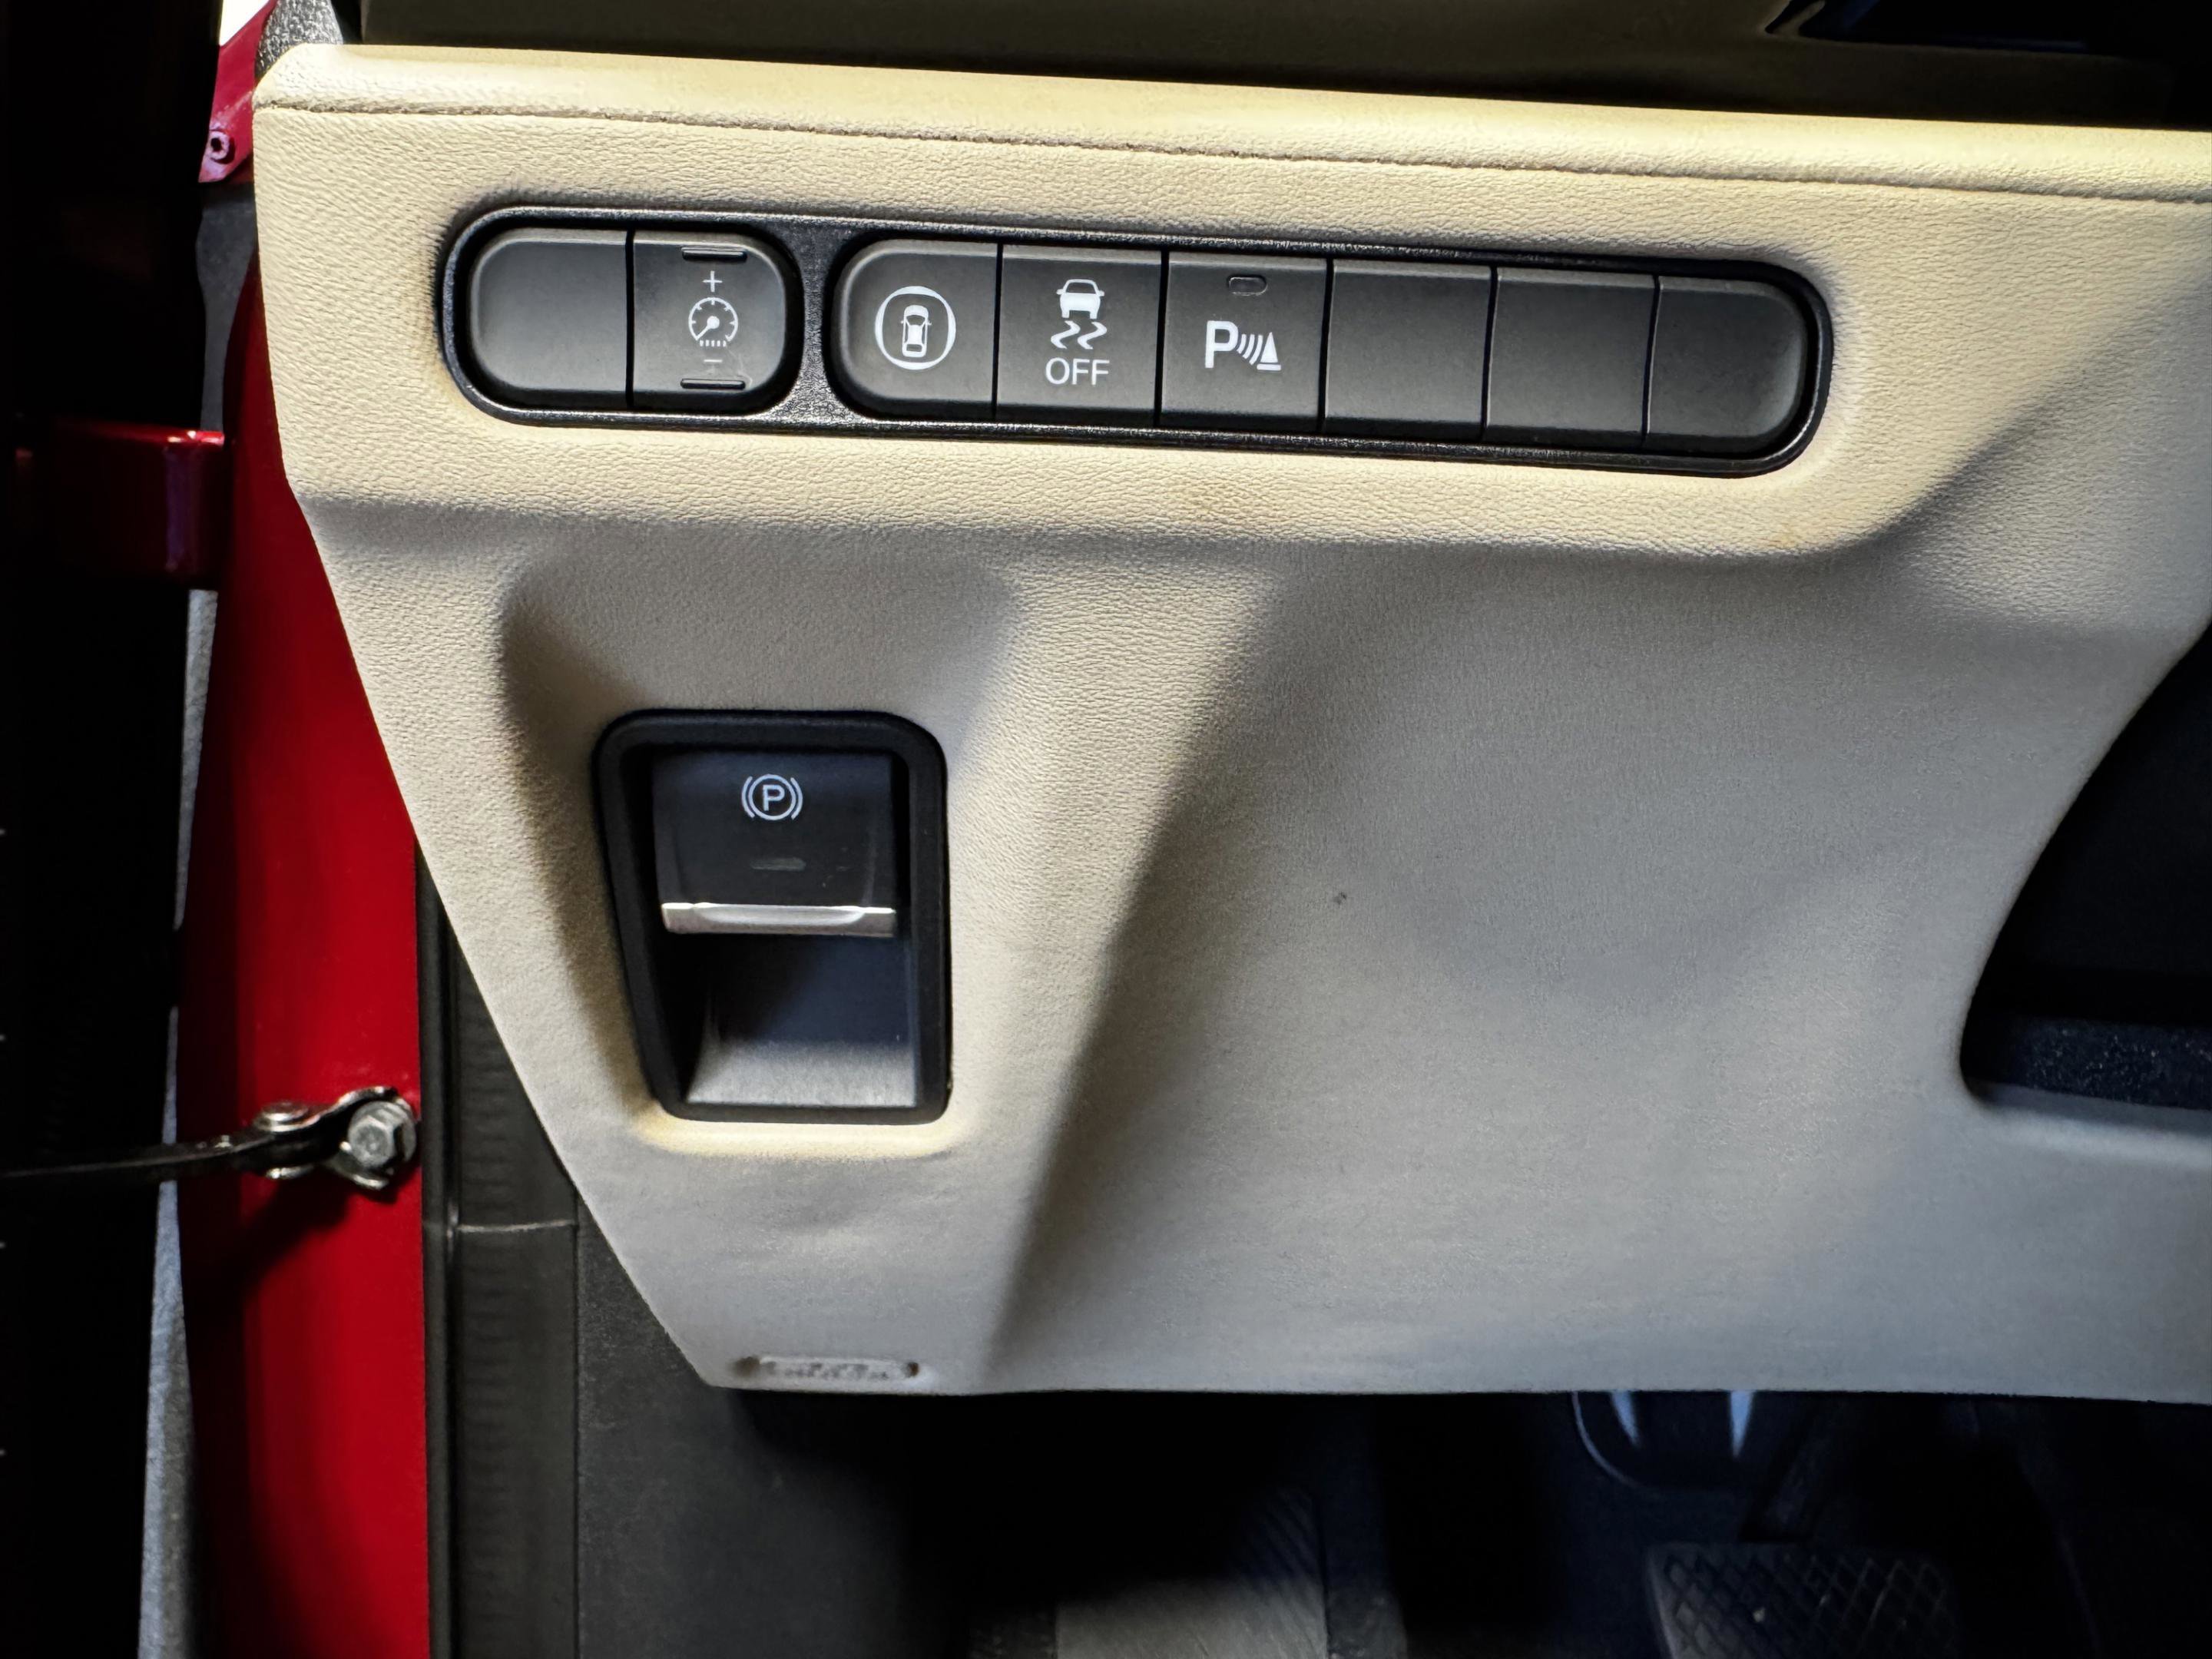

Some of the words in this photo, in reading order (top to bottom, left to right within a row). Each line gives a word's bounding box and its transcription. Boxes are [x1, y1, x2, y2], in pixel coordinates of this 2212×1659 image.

[1205, 320, 1239, 368] P
[1045, 357, 1110, 386] OFF
[763, 784, 785, 811] P
